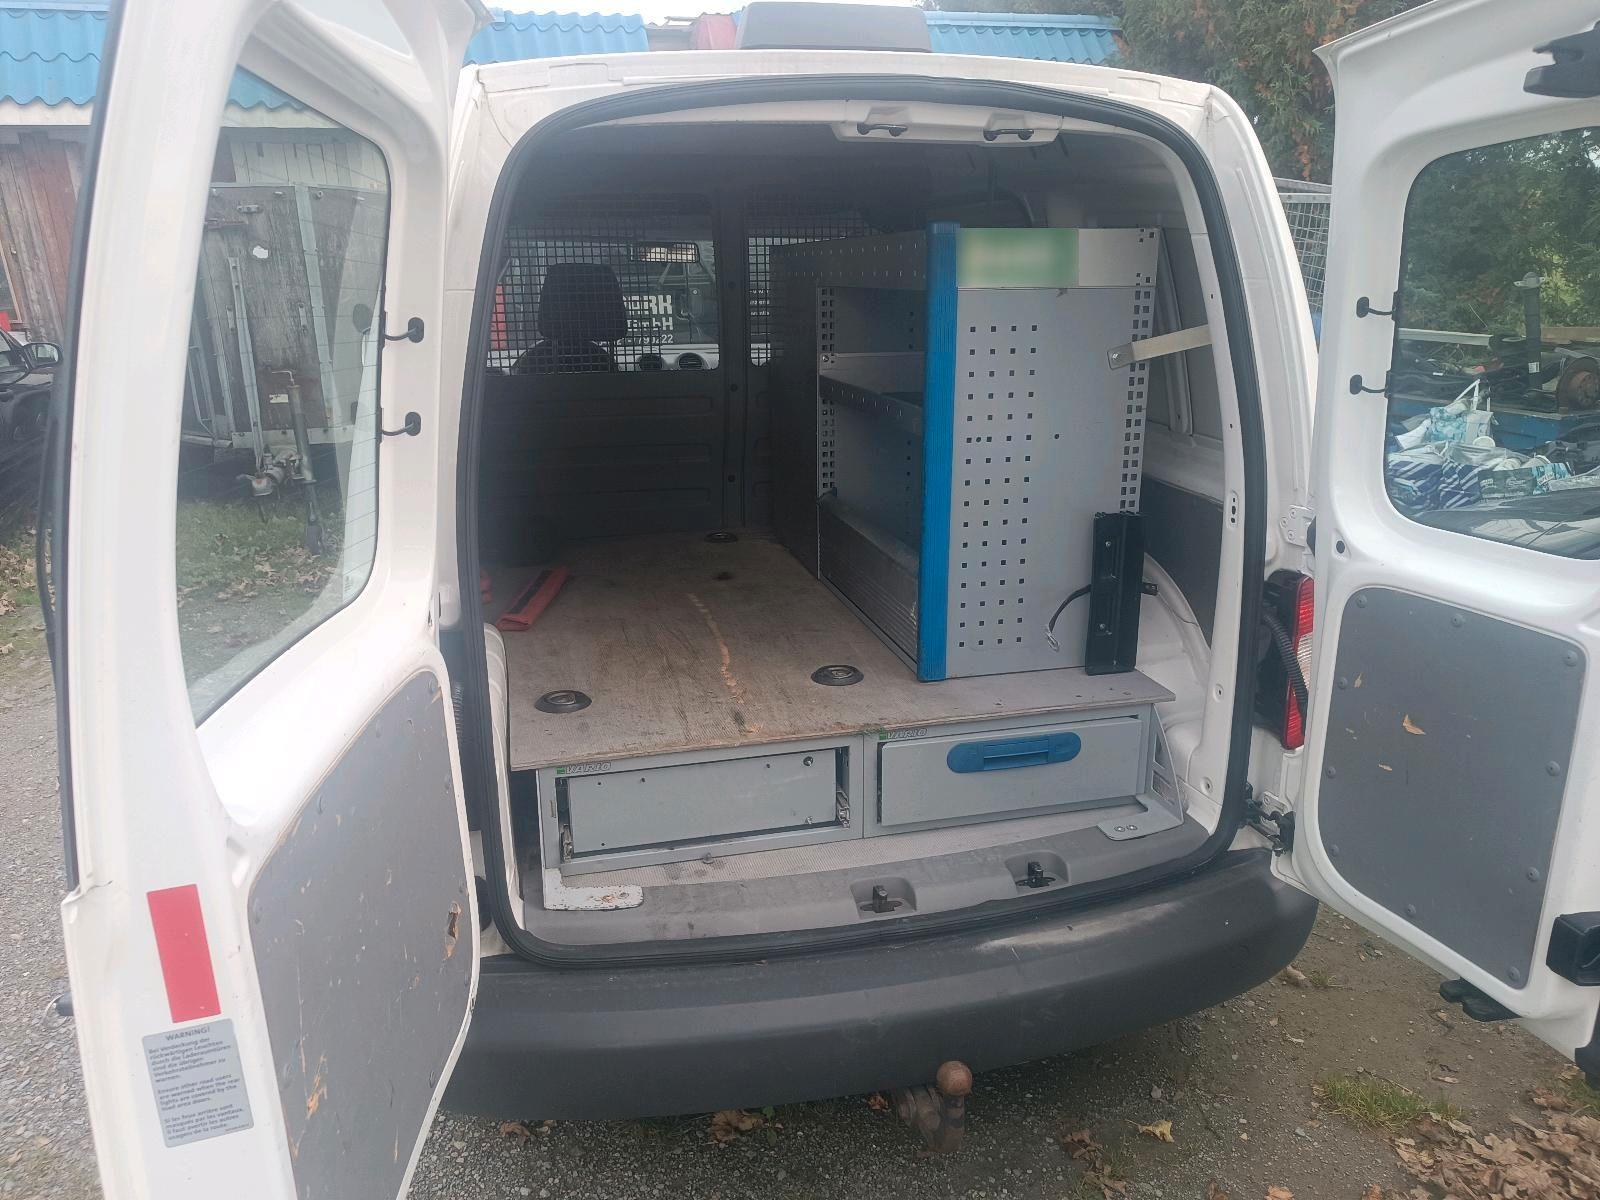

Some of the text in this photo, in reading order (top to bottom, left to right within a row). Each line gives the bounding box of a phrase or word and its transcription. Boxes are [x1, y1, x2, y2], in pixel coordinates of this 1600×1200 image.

[887, 728, 928, 739] VARIO
[566, 762, 611, 774] VARIO
[165, 1027, 210, 1041] WARNING!
